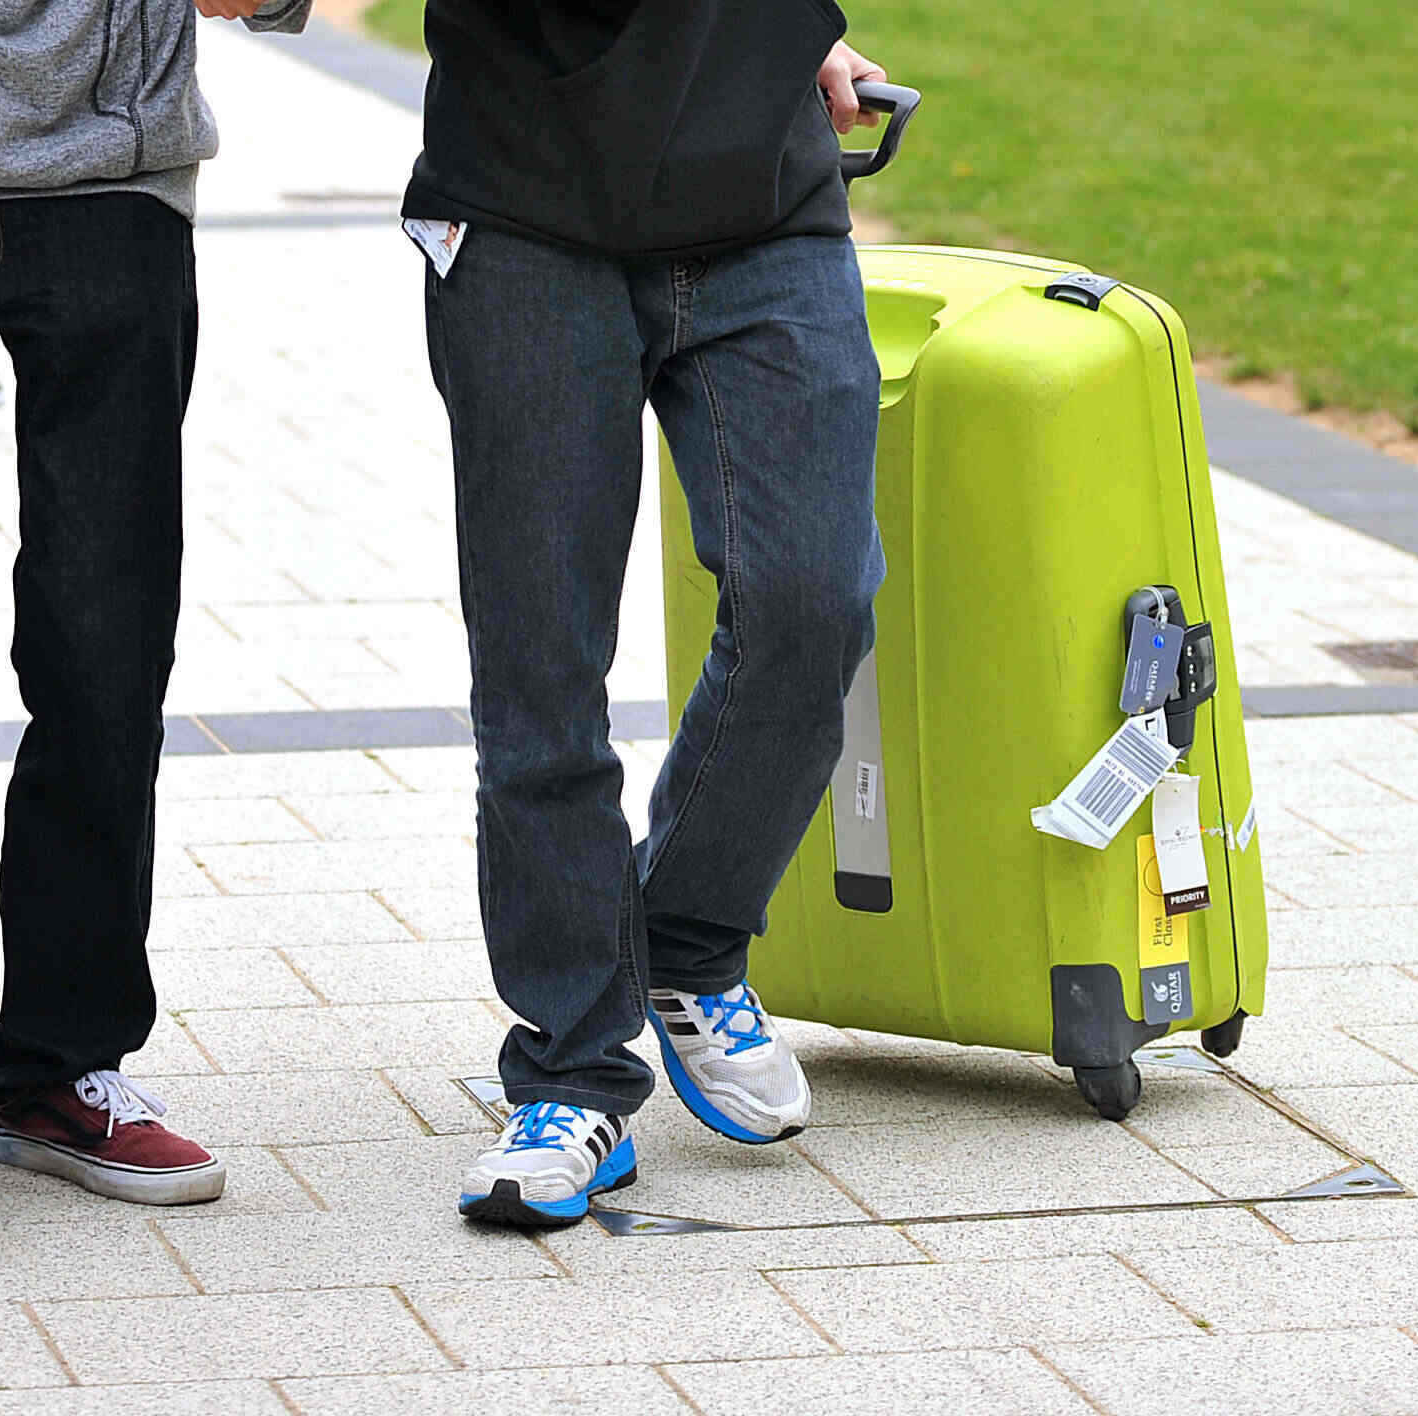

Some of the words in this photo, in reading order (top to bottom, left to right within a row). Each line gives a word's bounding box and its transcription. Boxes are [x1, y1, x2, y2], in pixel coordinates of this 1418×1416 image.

[1170, 890, 1205, 905] PRIORITY
[1152, 916, 1162, 945] First
[1169, 971, 1181, 1013] QATAR
